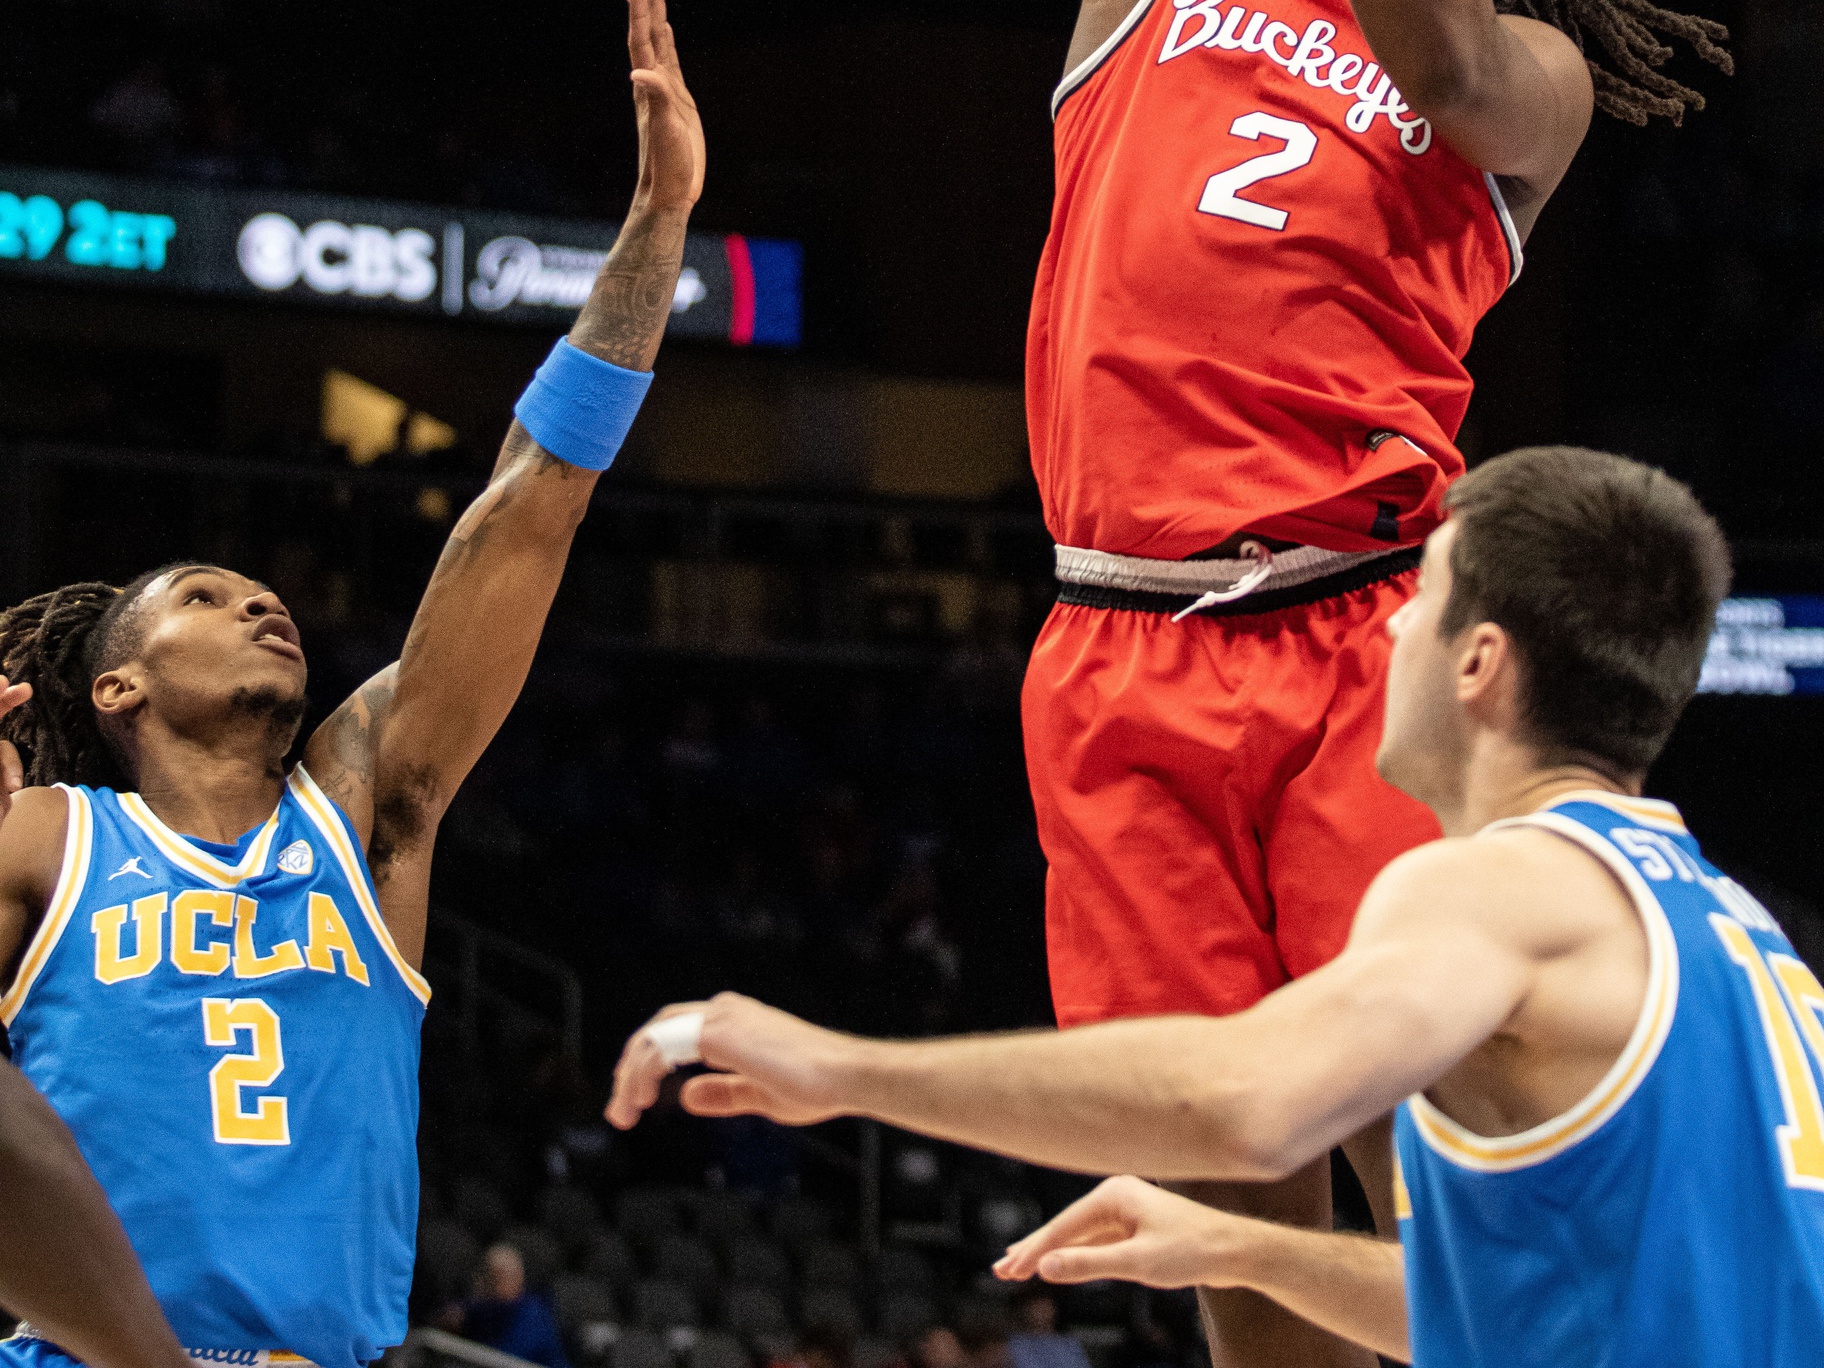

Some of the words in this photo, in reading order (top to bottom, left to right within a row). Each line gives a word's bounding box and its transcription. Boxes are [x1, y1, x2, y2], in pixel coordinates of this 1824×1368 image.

[1196, 111, 1318, 232] 2
[301, 219, 437, 303] CBS
[91, 889, 370, 987] UCLA
[201, 998, 291, 1146] 2
